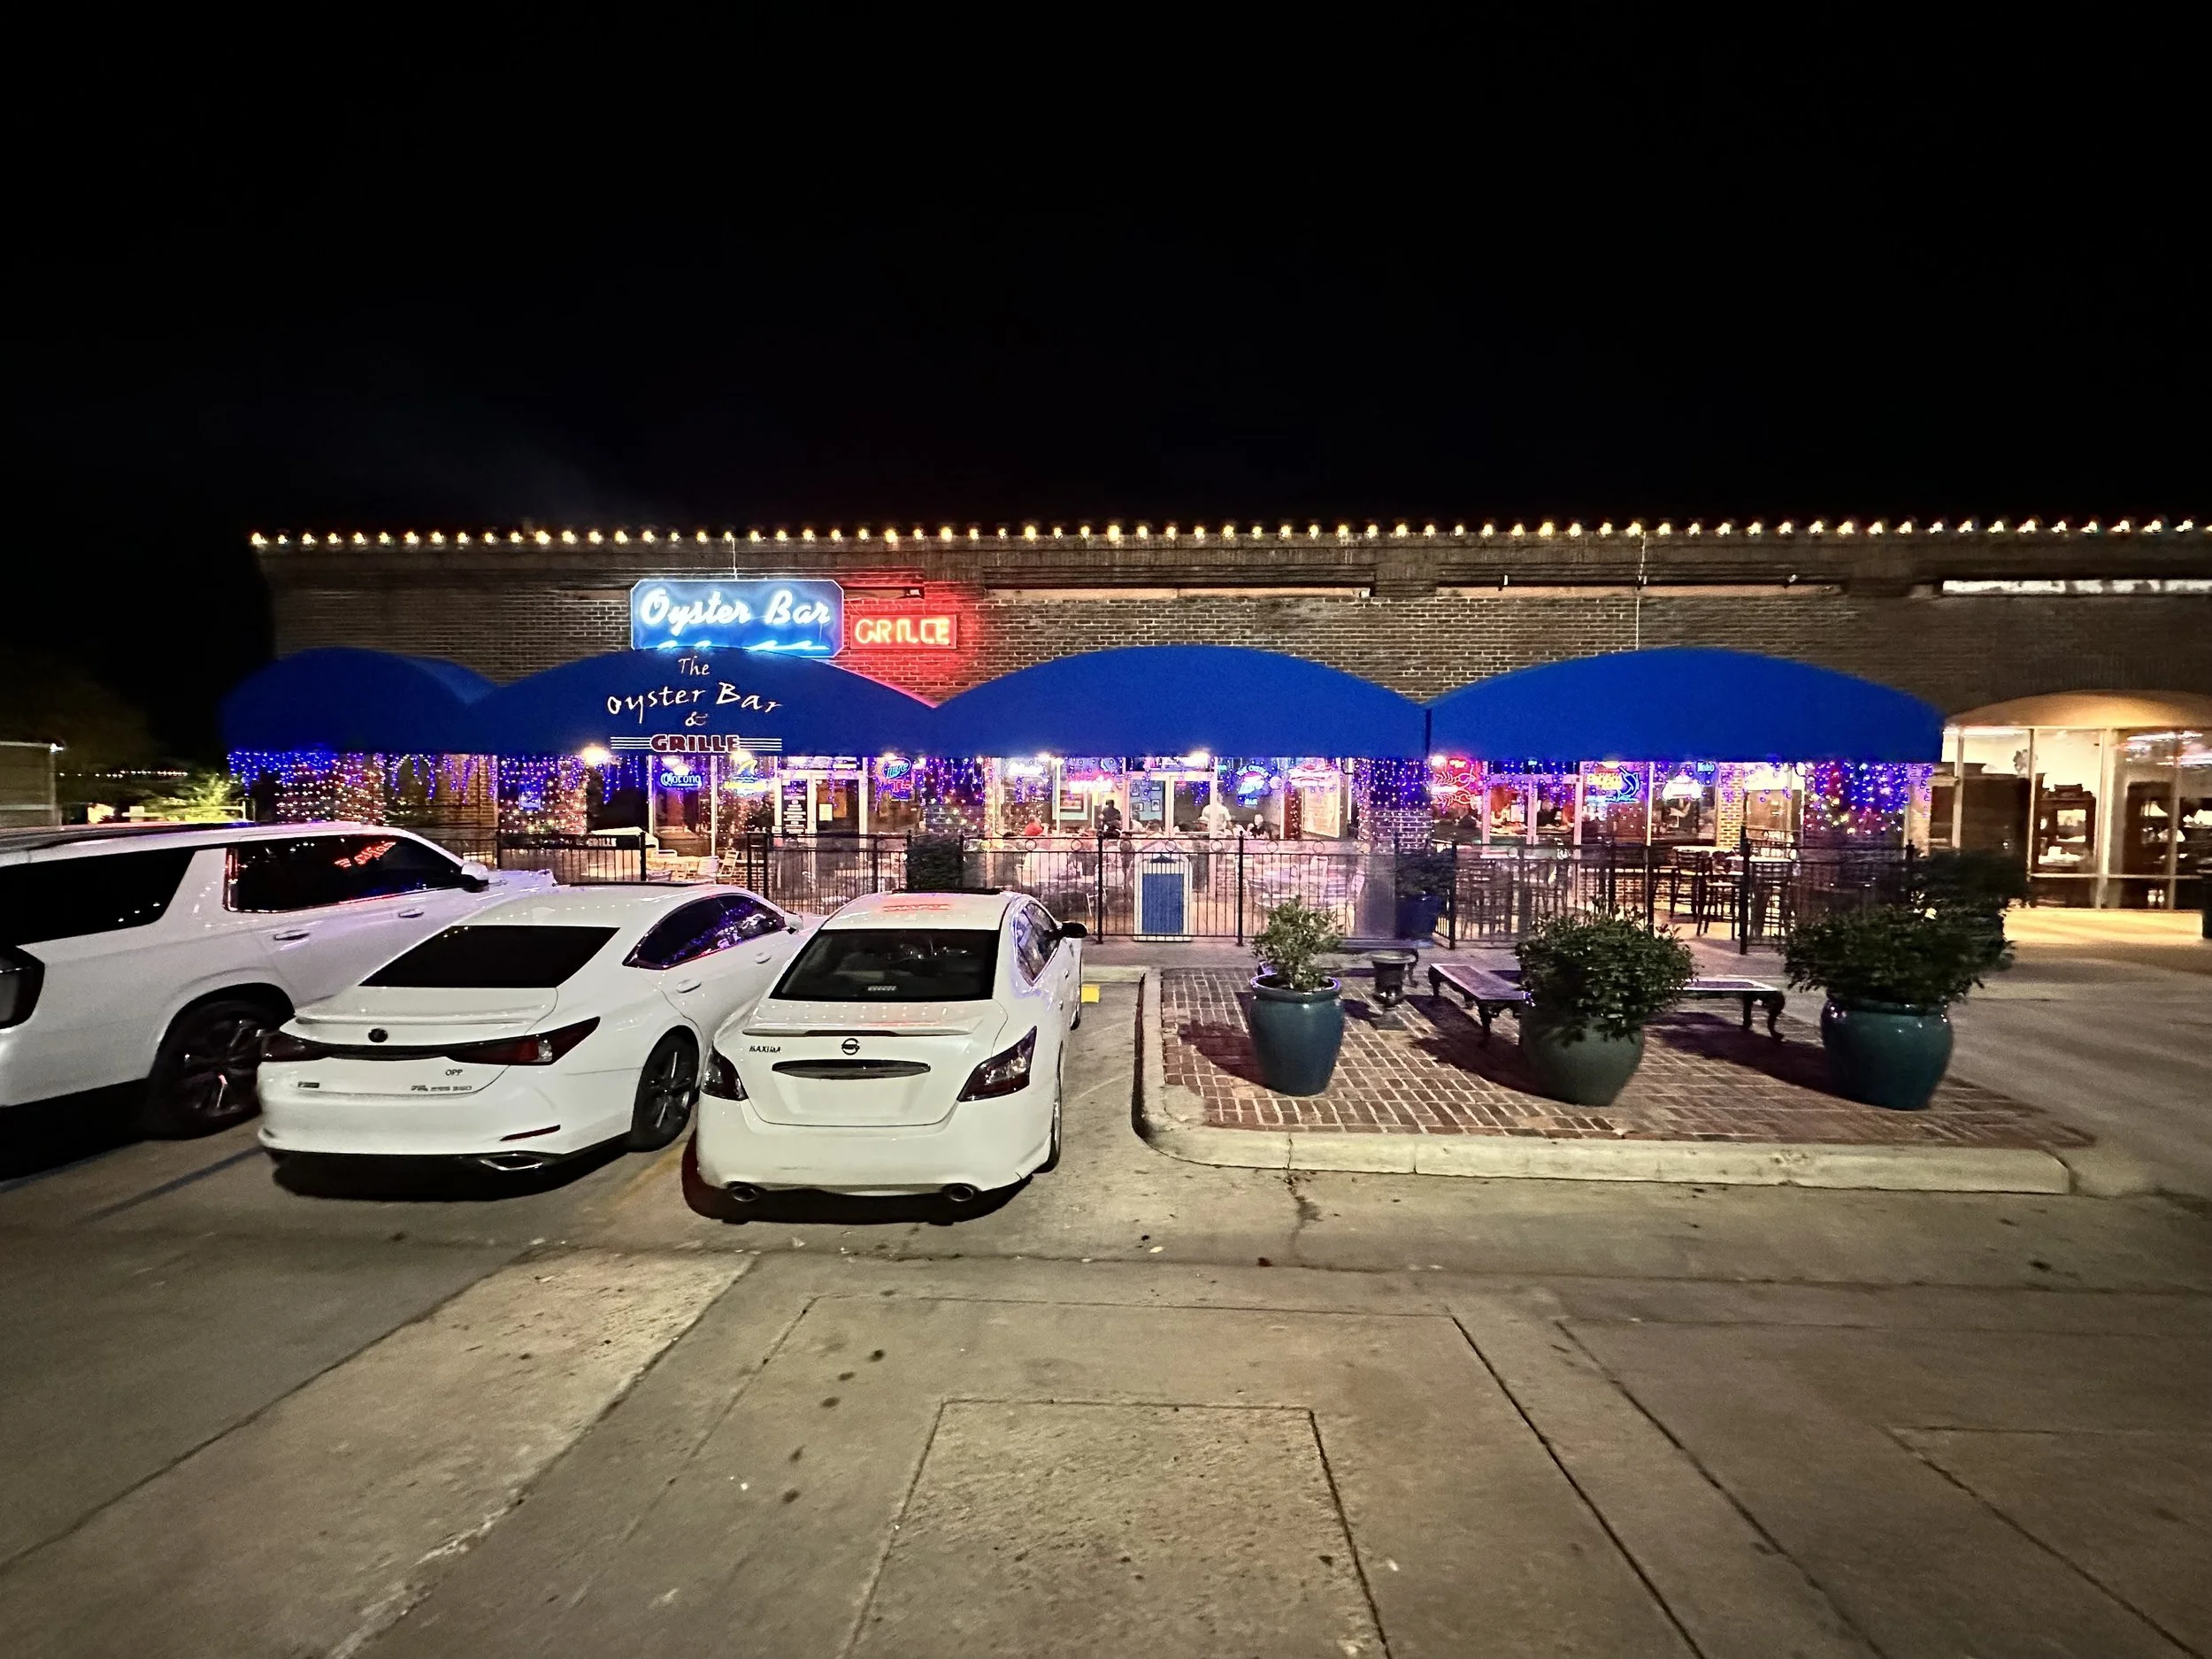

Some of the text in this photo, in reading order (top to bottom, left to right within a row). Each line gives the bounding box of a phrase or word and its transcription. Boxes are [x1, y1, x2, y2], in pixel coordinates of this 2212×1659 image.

[639, 587, 832, 636] Oyster Bar
[678, 656, 710, 677] The
[716, 681, 783, 714] Bar
[685, 711, 708, 726] &
[649, 733, 740, 753] GRILLE
[660, 772, 703, 788] Corona
